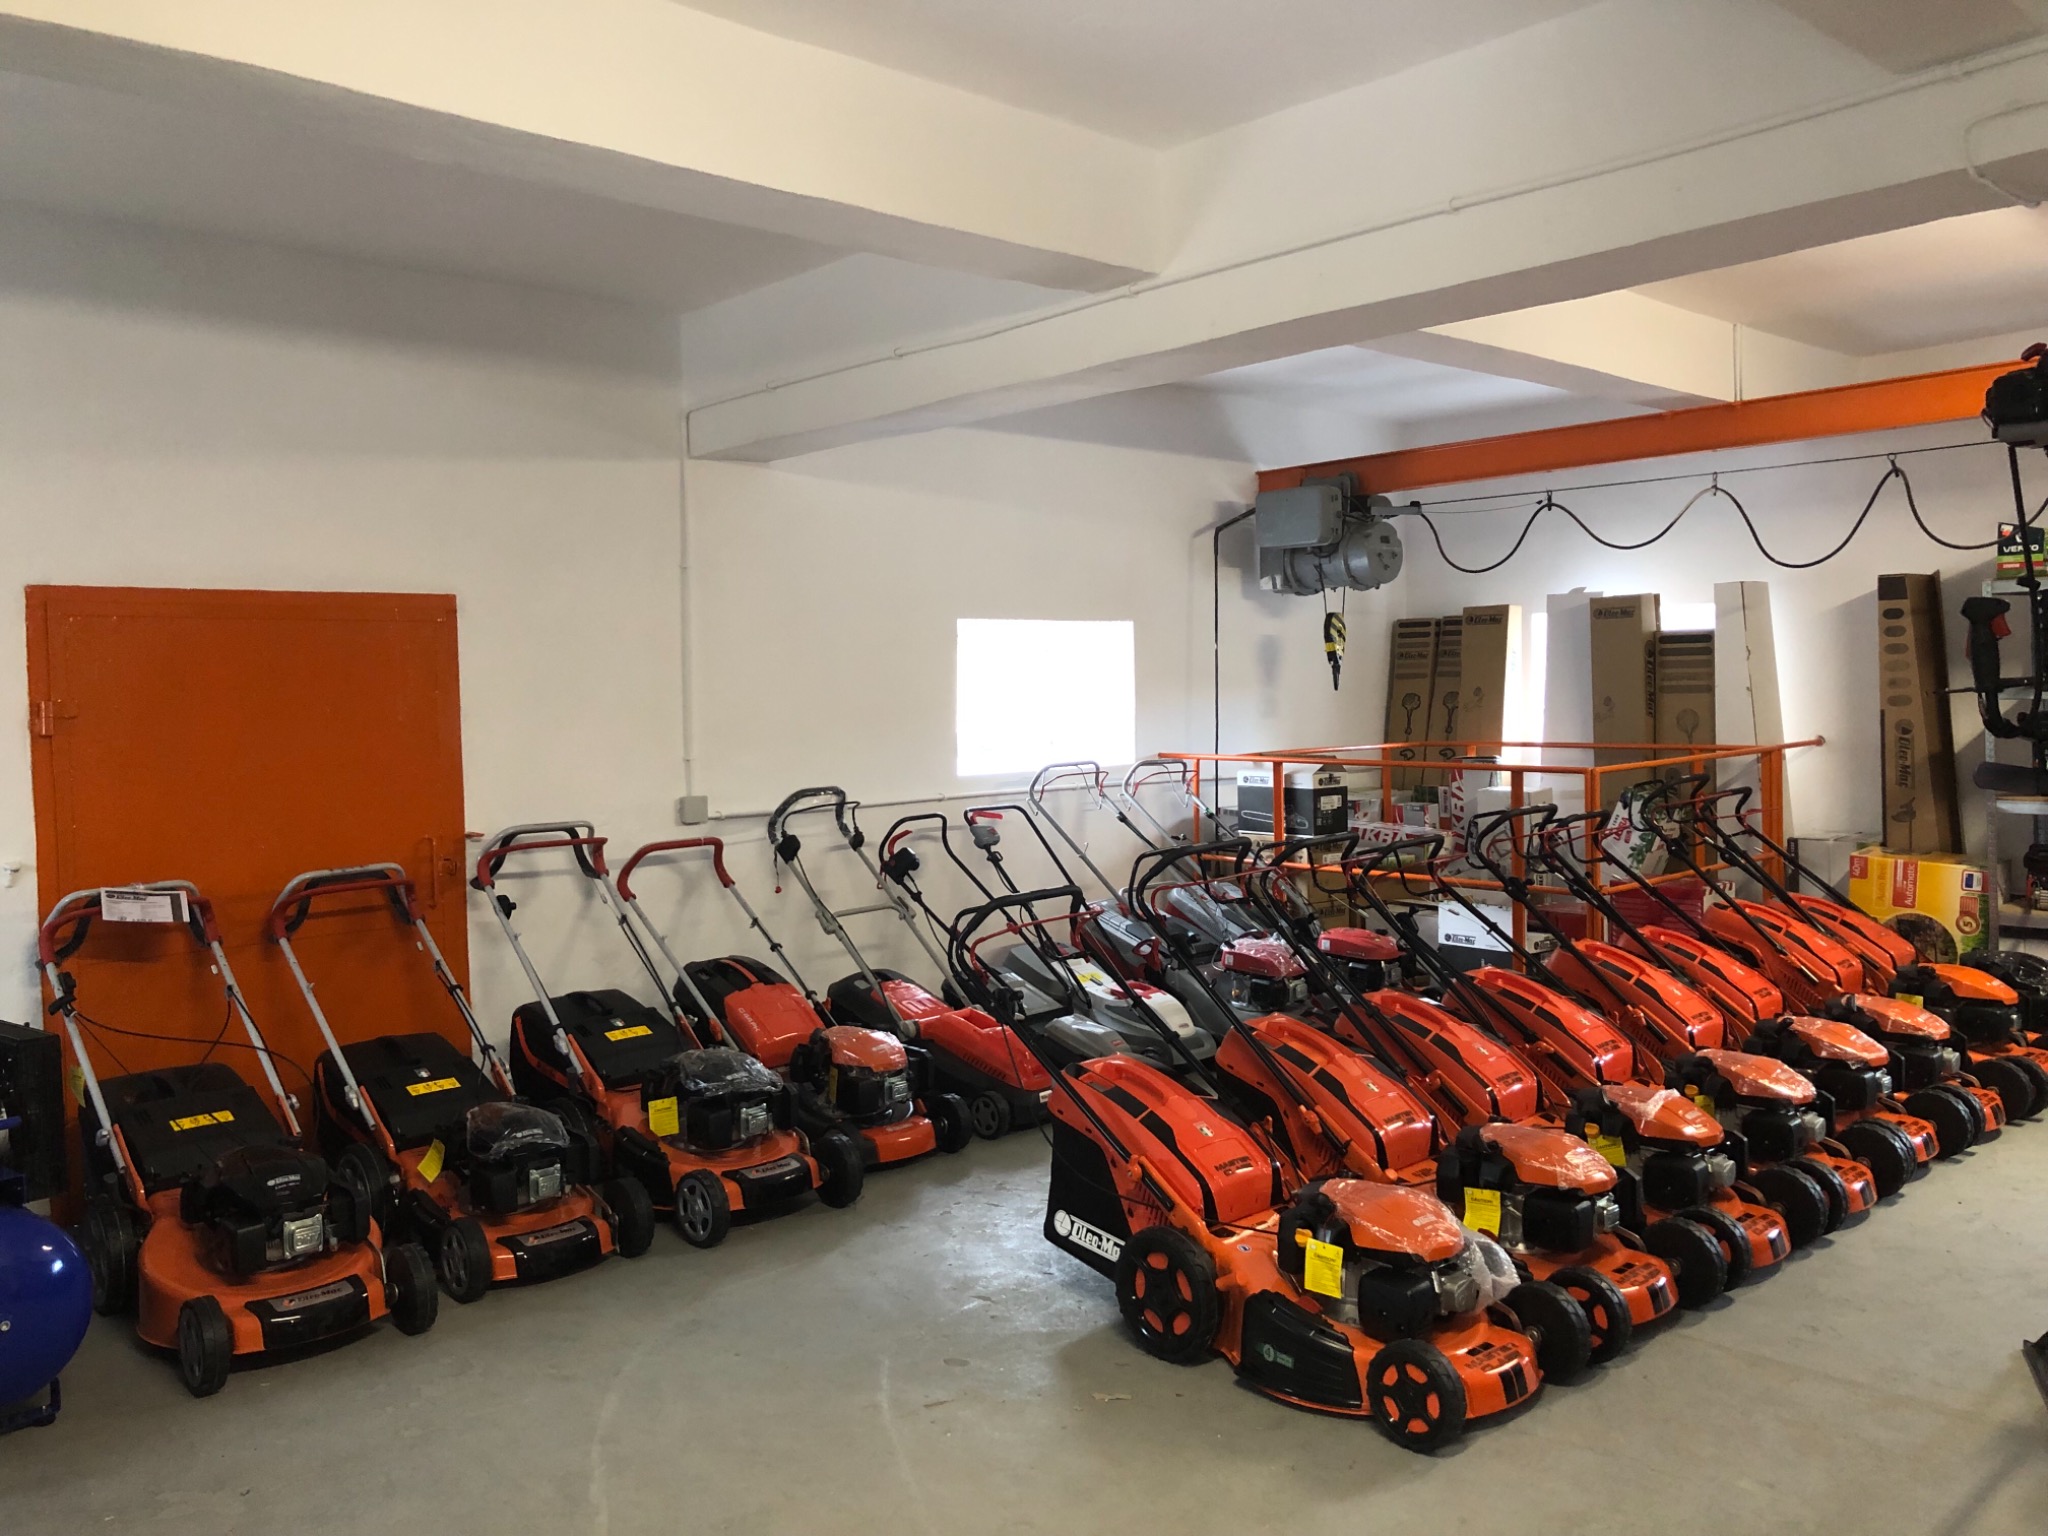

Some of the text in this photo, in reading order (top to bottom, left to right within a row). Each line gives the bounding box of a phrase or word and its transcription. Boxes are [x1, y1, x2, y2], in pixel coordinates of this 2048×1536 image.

[2002, 545, 2040, 554] VERO
[1904, 863, 1915, 905] Automatic
[1963, 920, 1973, 928] 5
